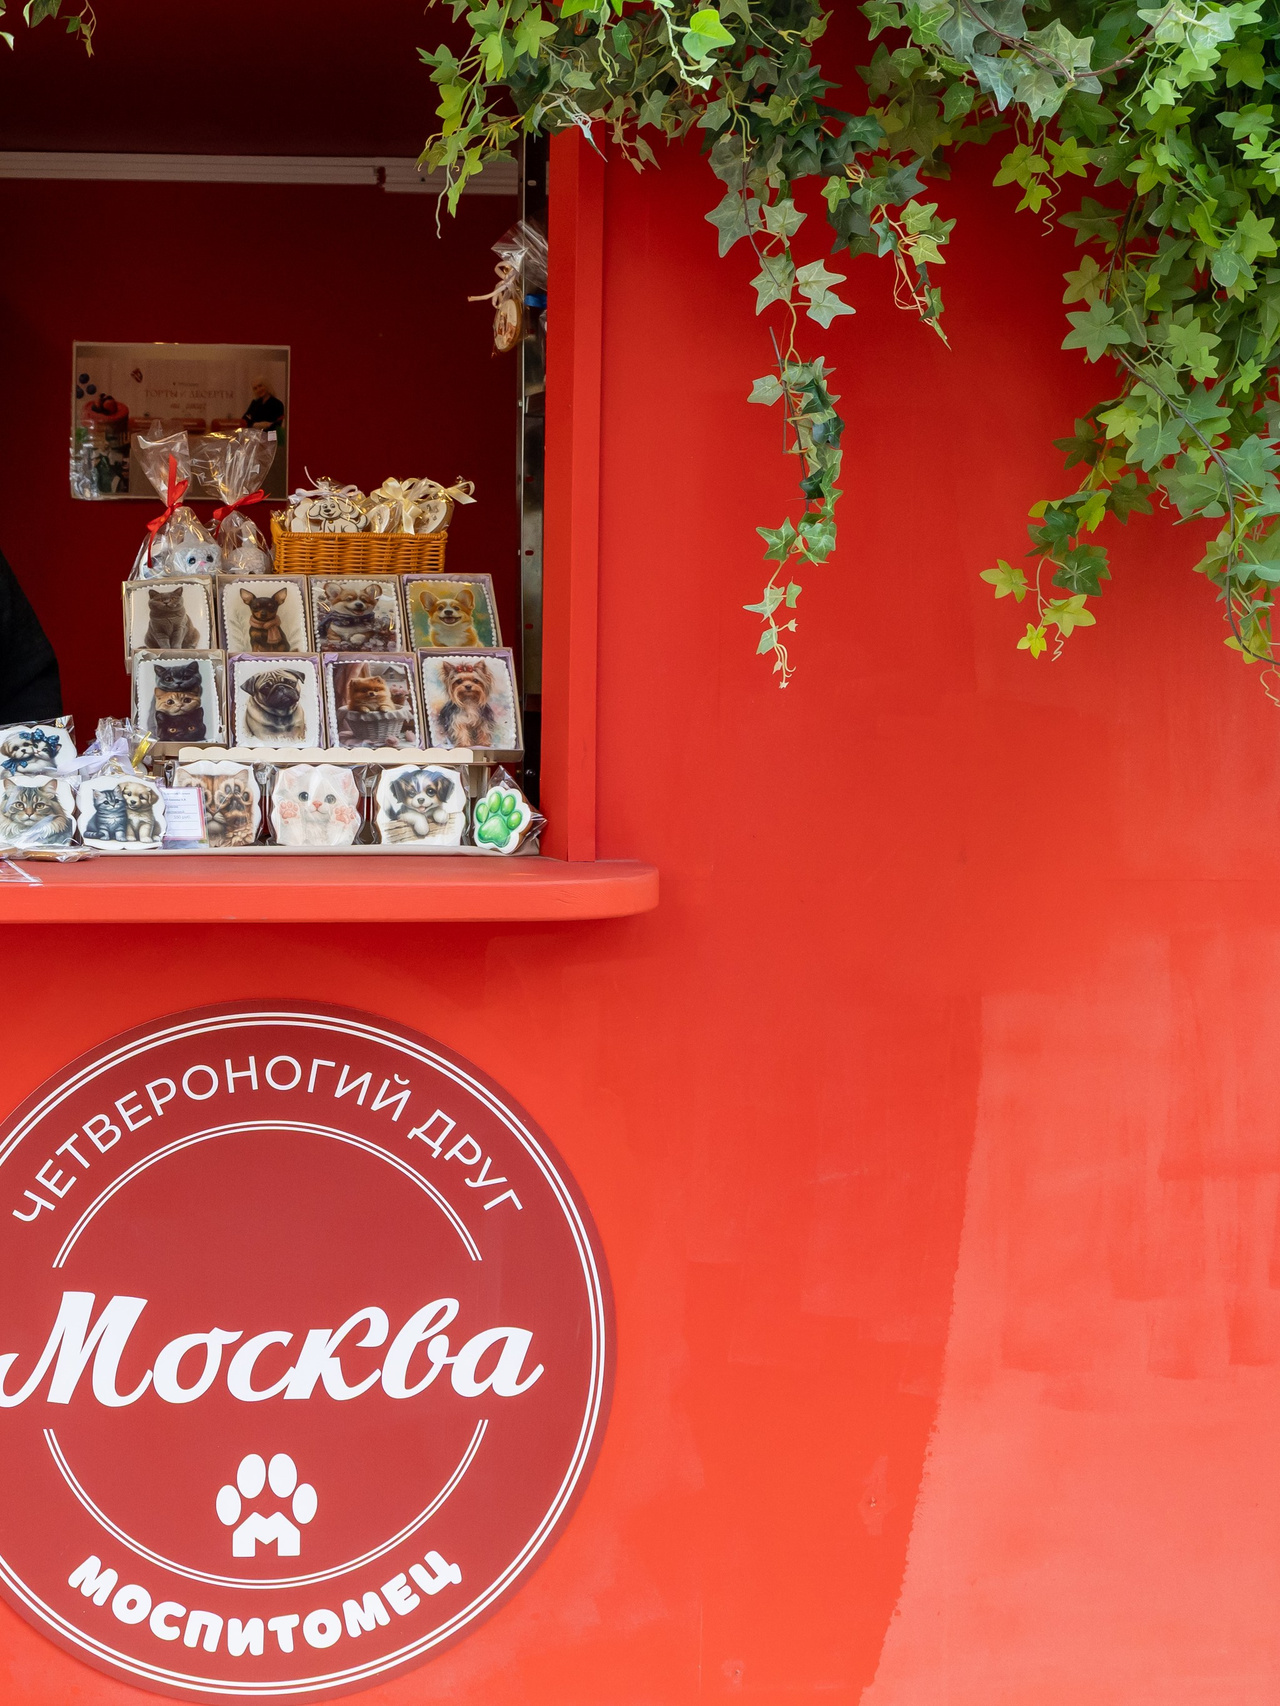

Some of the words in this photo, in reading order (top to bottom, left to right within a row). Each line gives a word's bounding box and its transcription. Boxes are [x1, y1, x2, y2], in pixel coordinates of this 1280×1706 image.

[189, 389, 234, 399] ДЕСЕРТЫ
[12, 1055, 412, 1222] ЧЕТВЕРОНОГИЙ
[407, 1108, 523, 1211] ДРУГ
[68, 1551, 463, 1657] МОСПИТОМЕЦ
